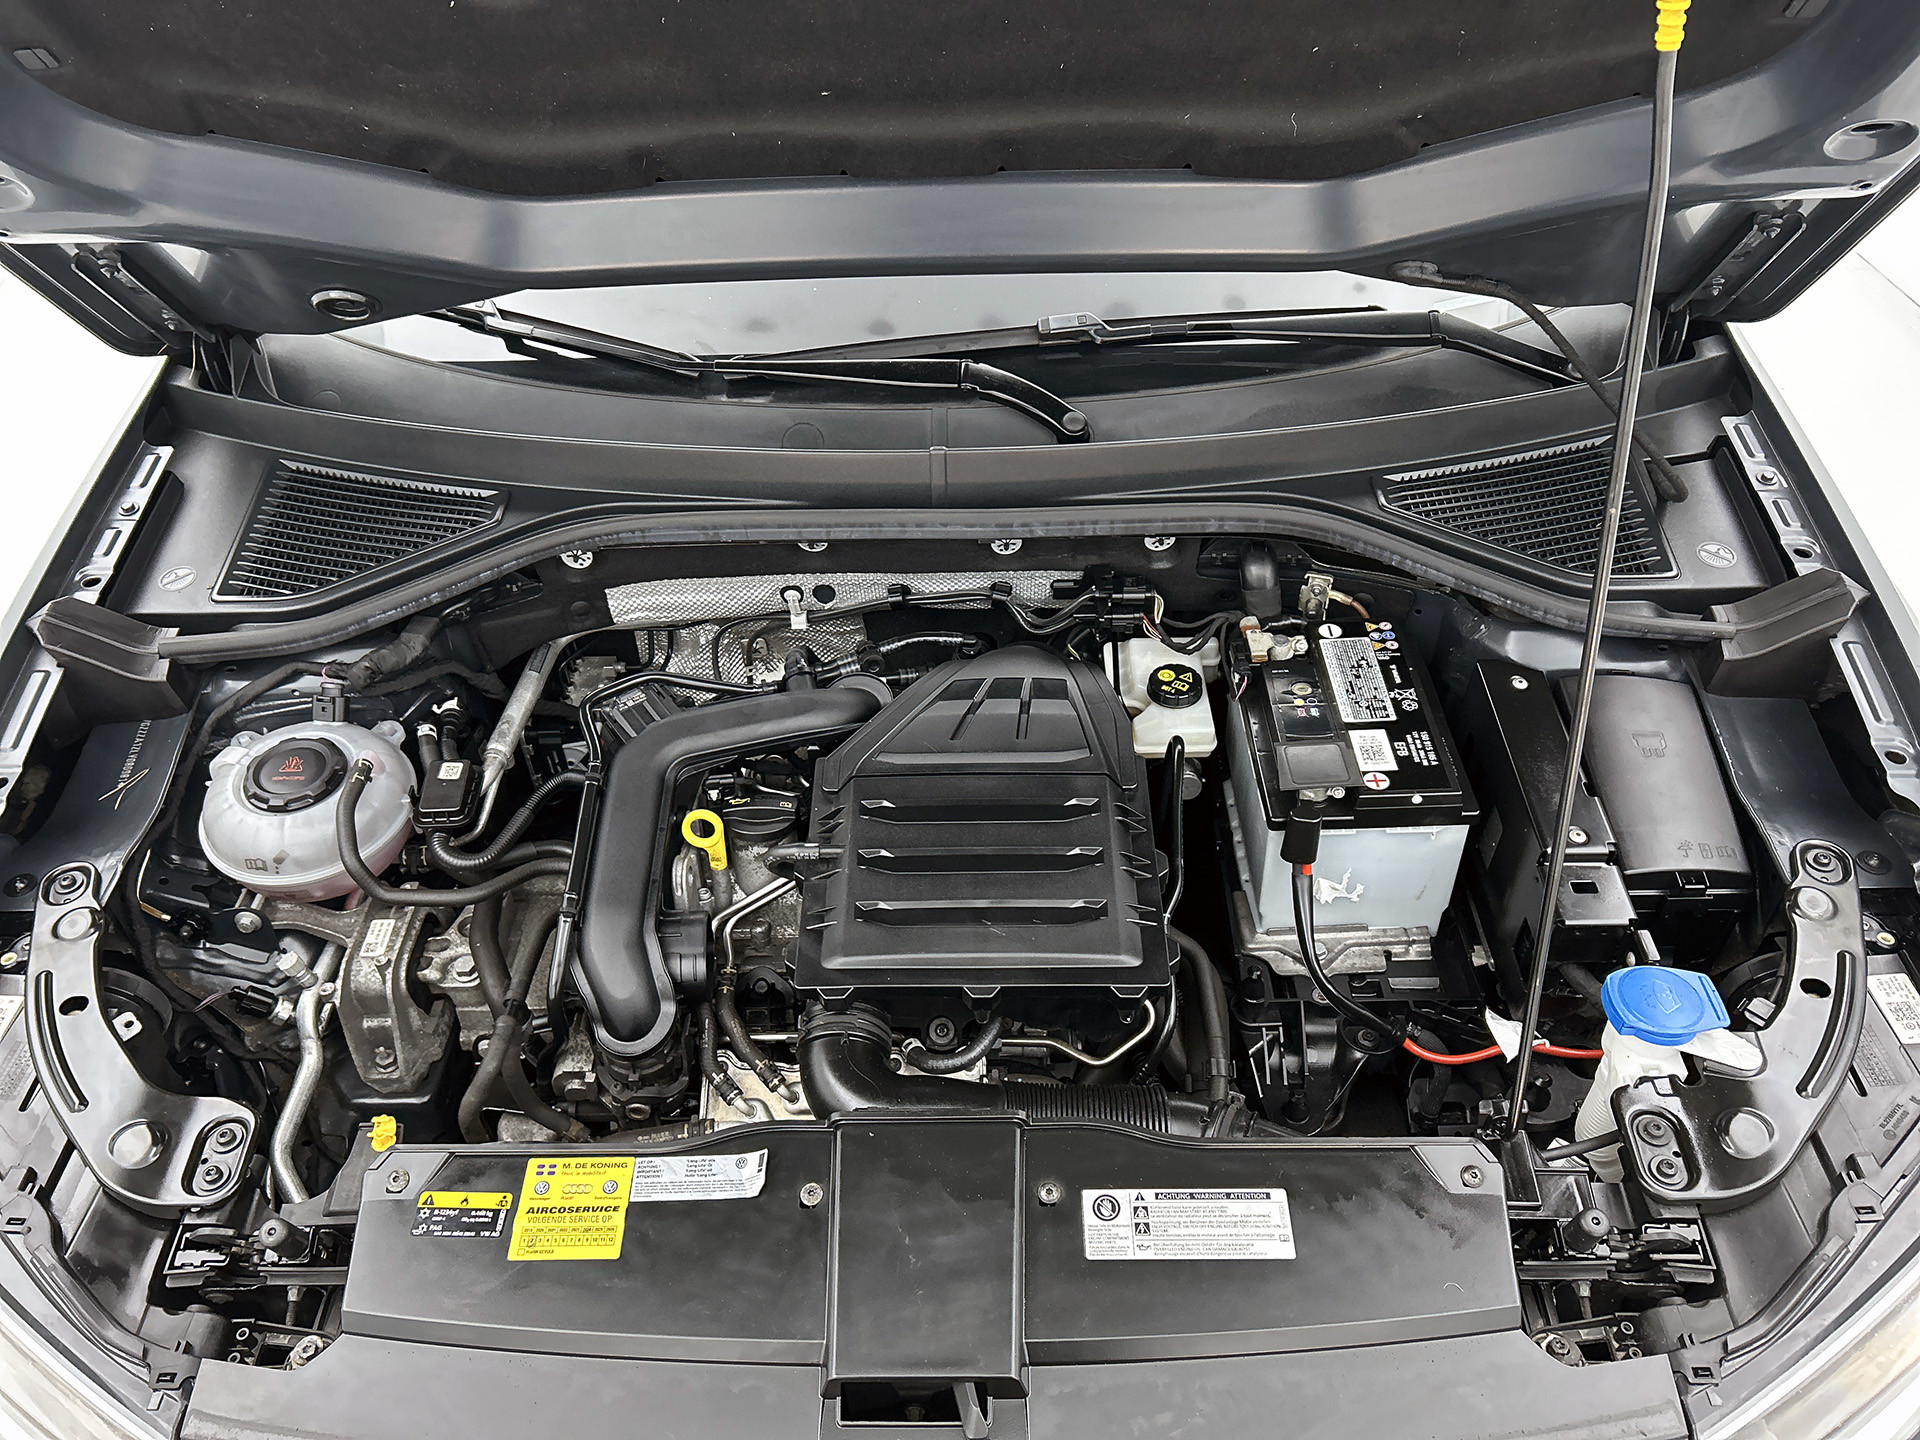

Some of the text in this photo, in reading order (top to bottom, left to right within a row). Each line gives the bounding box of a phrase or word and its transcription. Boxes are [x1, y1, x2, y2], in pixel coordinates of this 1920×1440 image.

[1394, 742, 1409, 756] EFB
[526, 1206, 620, 1214] AIRCOSERVICE
[527, 1216, 567, 1224] VOLGENDE
[569, 1215, 600, 1224] SERVICE
